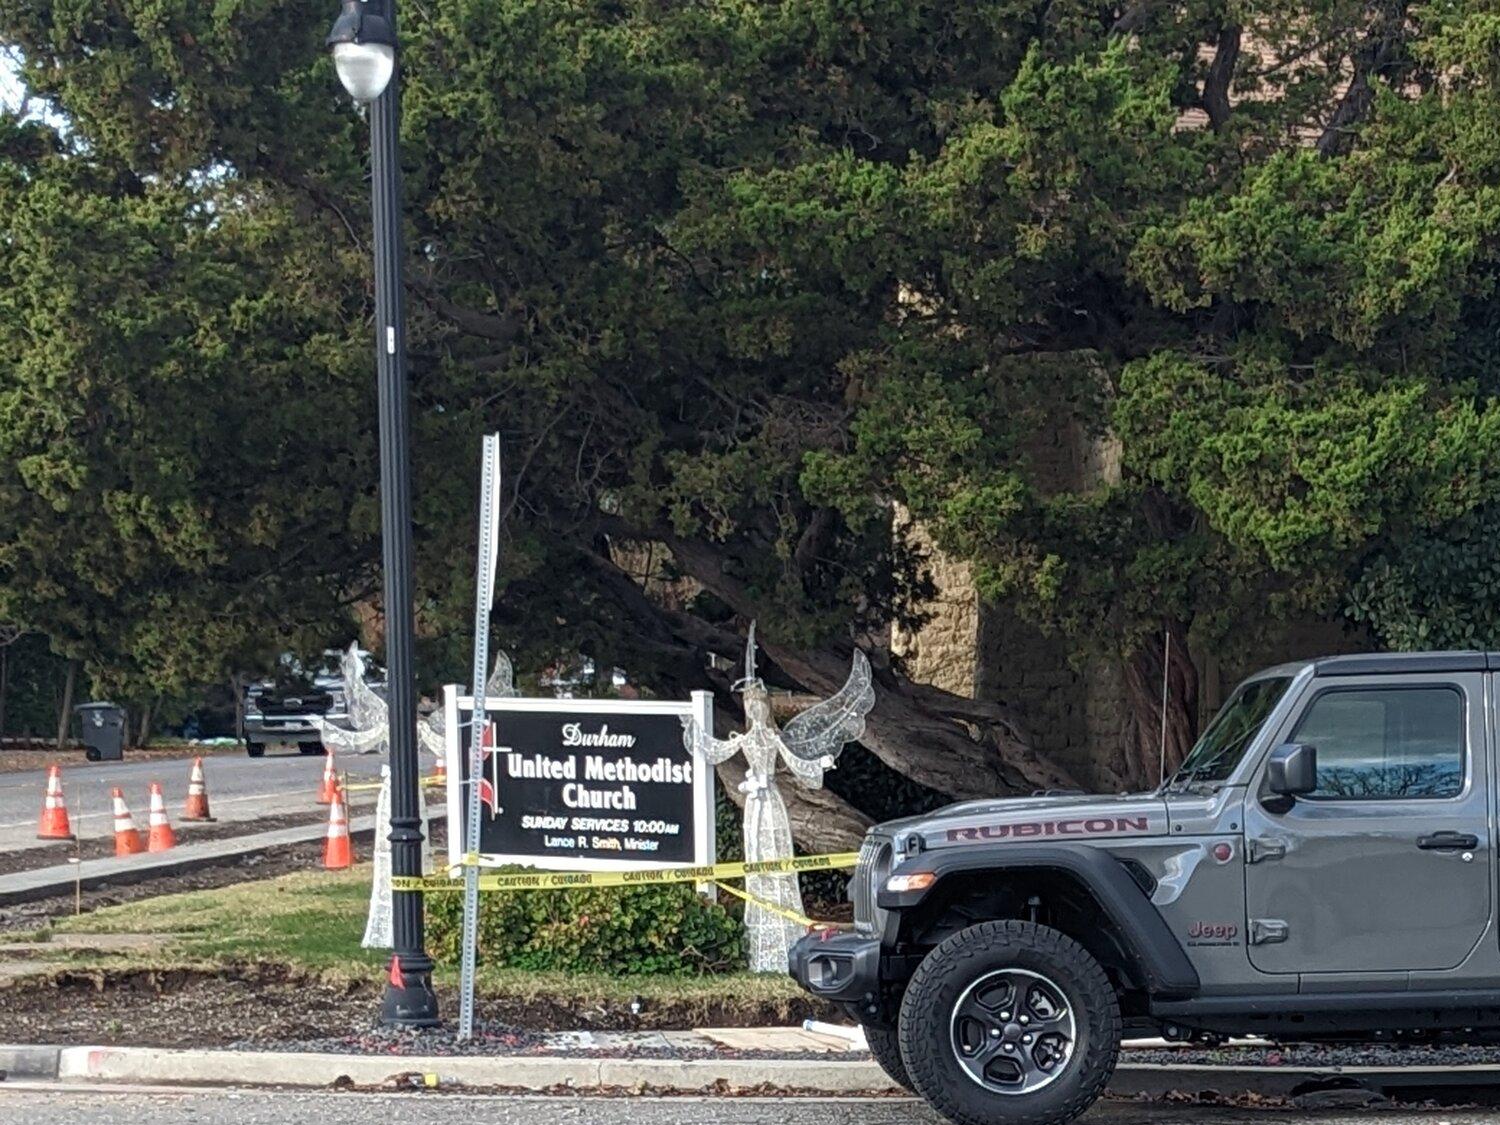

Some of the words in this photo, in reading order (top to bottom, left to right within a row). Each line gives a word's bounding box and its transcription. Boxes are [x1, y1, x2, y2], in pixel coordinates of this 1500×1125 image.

[562, 723, 637, 748] Durham
[507, 753, 576, 780] United
[585, 755, 692, 784] Methodist
[562, 783, 637, 811] Church
[521, 815, 569, 830] SUNDAY
[571, 817, 629, 833] SERVICES
[947, 817, 1148, 842] RUBICON
[544, 835, 575, 849] Lance
[578, 836, 589, 849] R.
[592, 837, 623, 851] Smith,
[624, 837, 660, 851] Minister
[497, 876, 540, 887] CAUTION
[1188, 921, 1238, 941] Jeep
